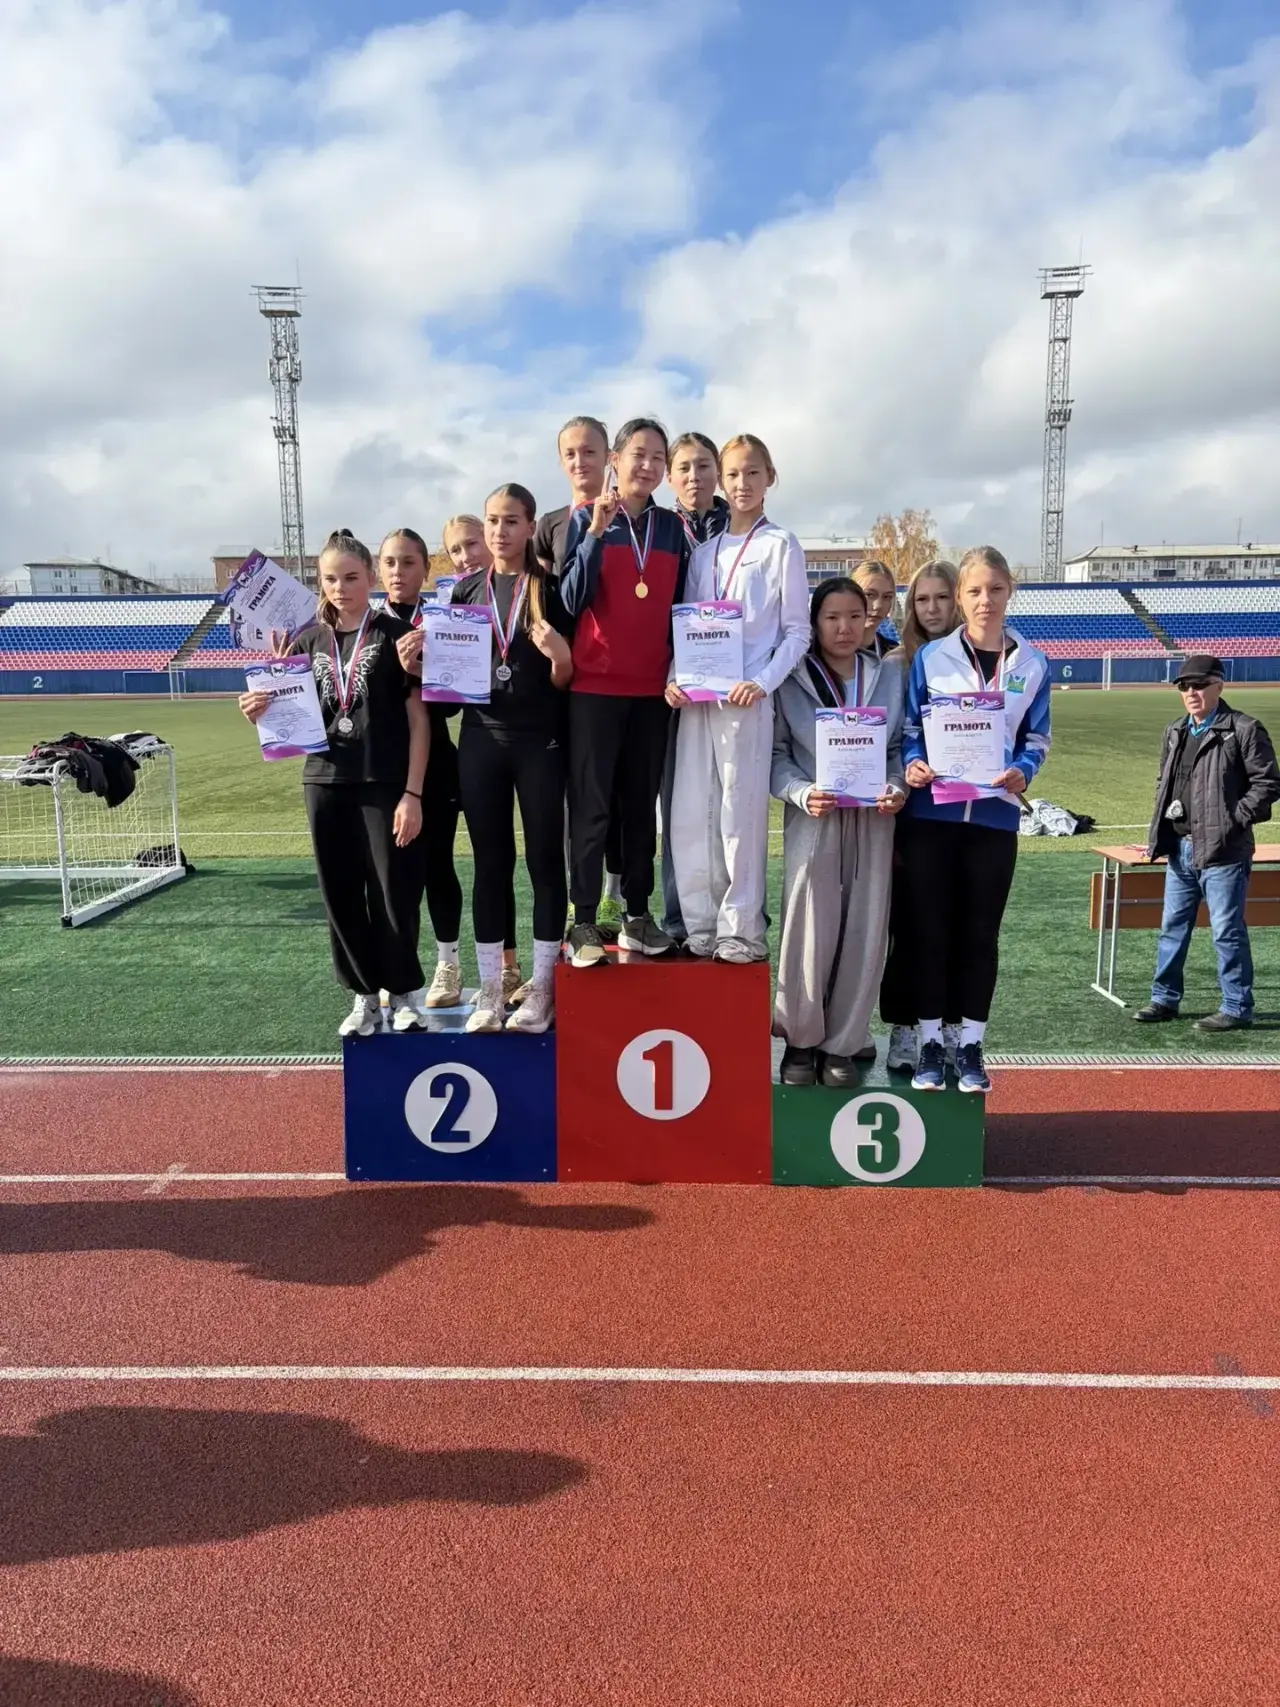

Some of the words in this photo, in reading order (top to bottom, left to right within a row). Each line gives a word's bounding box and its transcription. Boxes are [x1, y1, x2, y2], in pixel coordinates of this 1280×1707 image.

[248, 576, 276, 611] ГРАМОТА
[435, 632, 480, 642] ГРАМОТА
[686, 630, 731, 641] ГРАМОТА
[1062, 665, 1073, 678] 6
[33, 676, 43, 688] 2
[270, 684, 305, 698] АМОТА
[943, 721, 993, 731] ГРАМОТА
[828, 737, 875, 746] ГРАМОТА
[642, 1040, 675, 1111] 1
[428, 1072, 471, 1144] 2
[855, 1101, 901, 1175] 3
